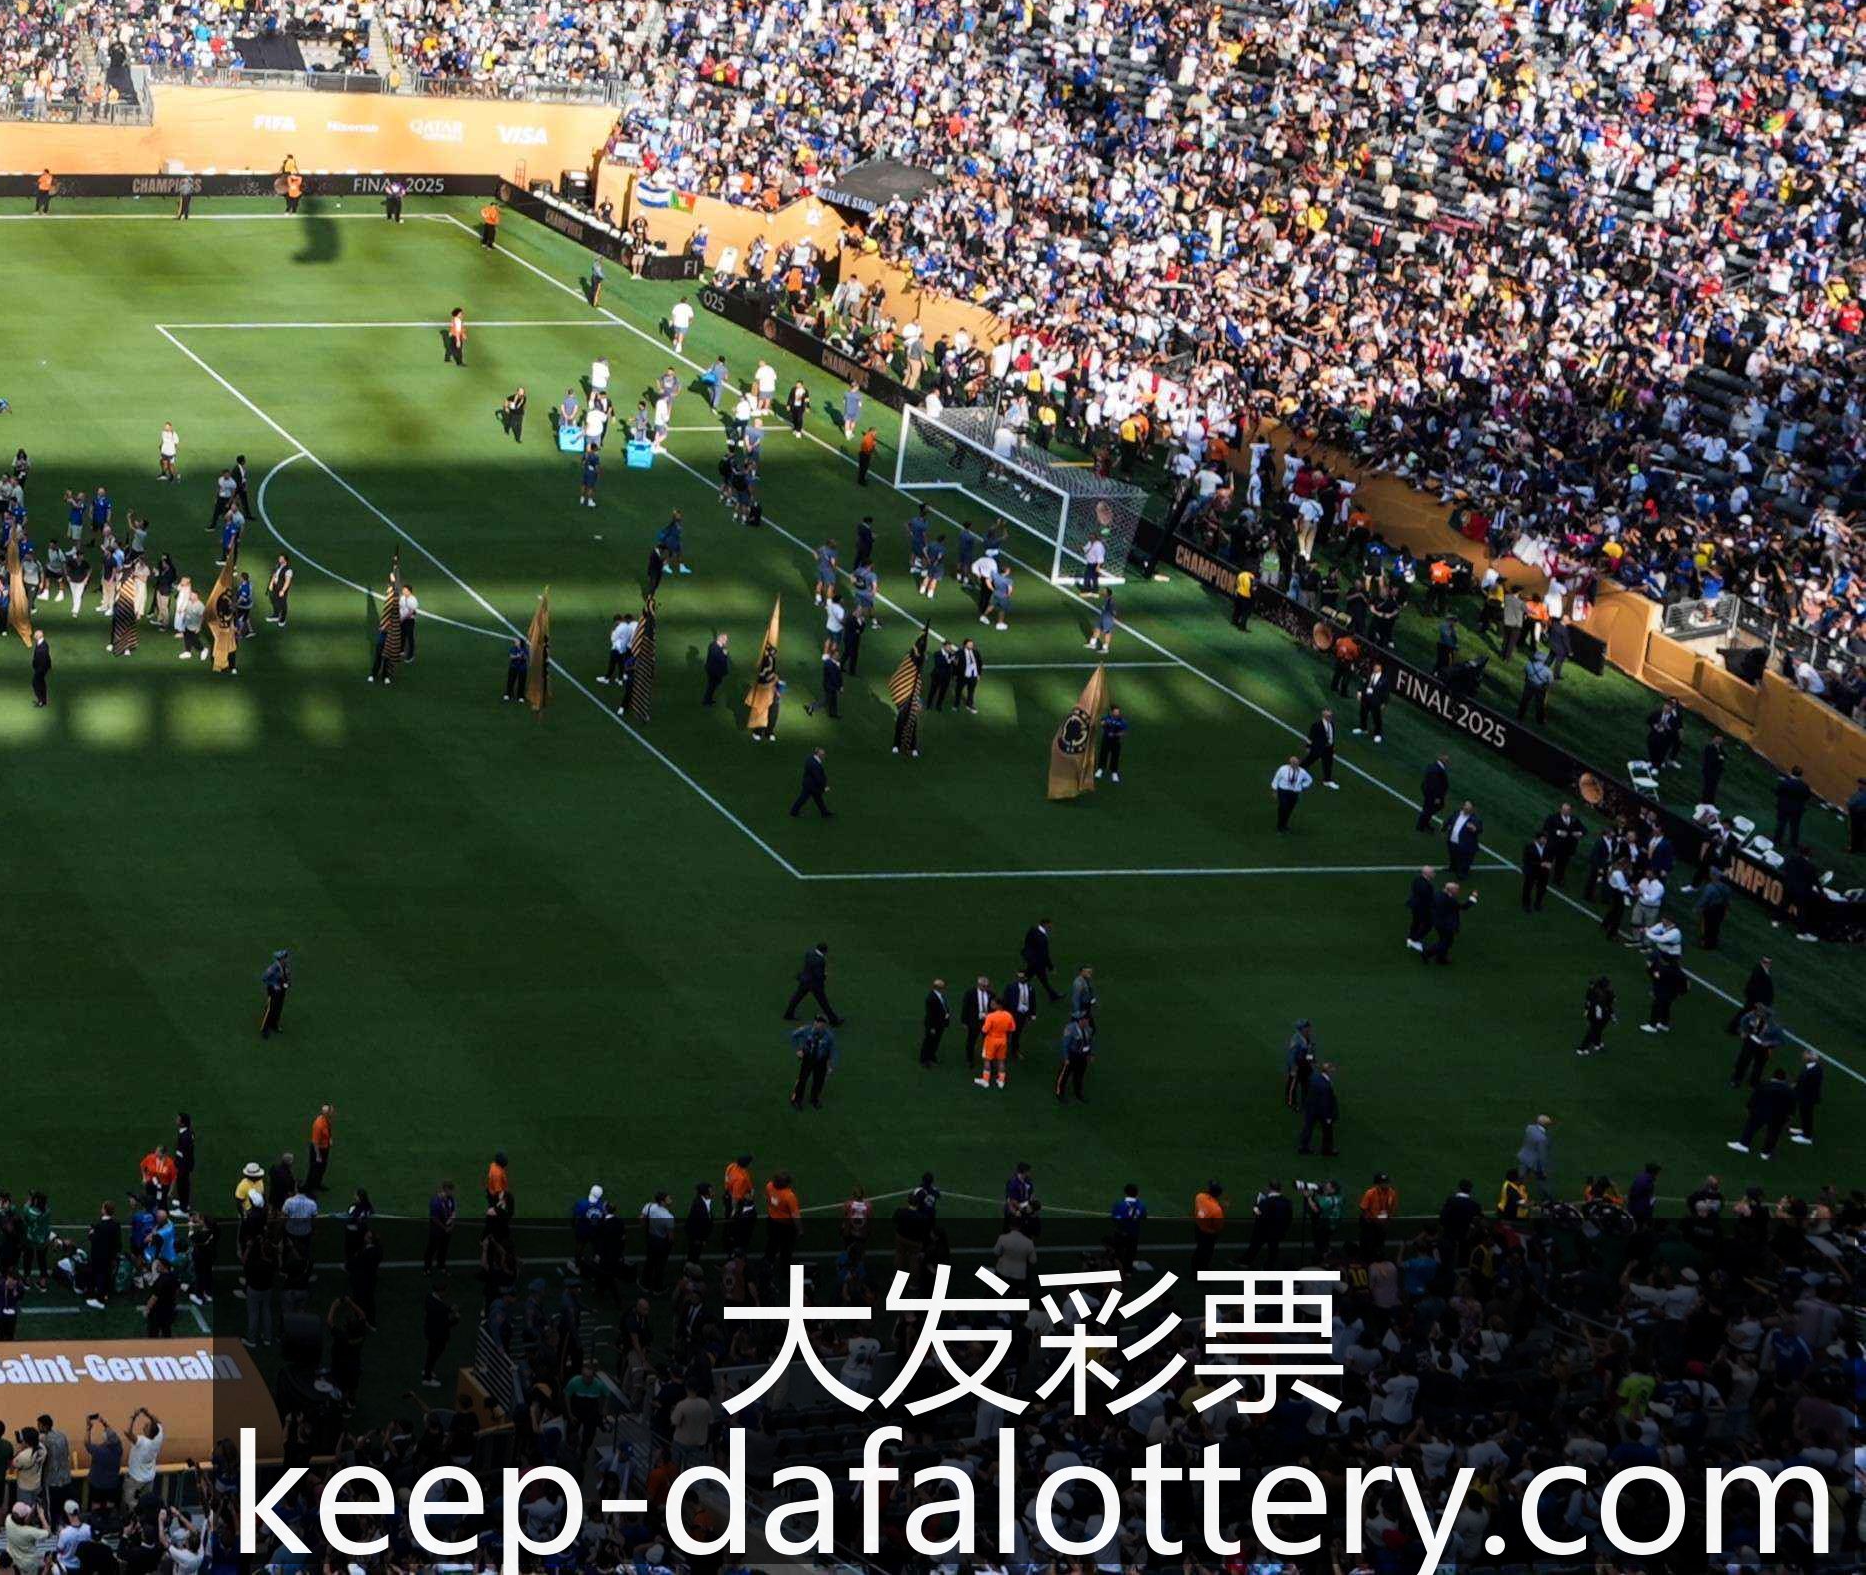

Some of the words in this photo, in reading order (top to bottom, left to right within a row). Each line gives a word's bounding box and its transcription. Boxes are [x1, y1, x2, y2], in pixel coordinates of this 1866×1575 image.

[496, 123, 549, 144] VISA
[353, 178, 392, 193] FINA
[405, 178, 445, 193] 2025
[702, 289, 726, 312] 025
[1175, 543, 1238, 596] CHAMPION
[1396, 669, 1453, 720] FINAL
[1456, 703, 1506, 748] 2025
